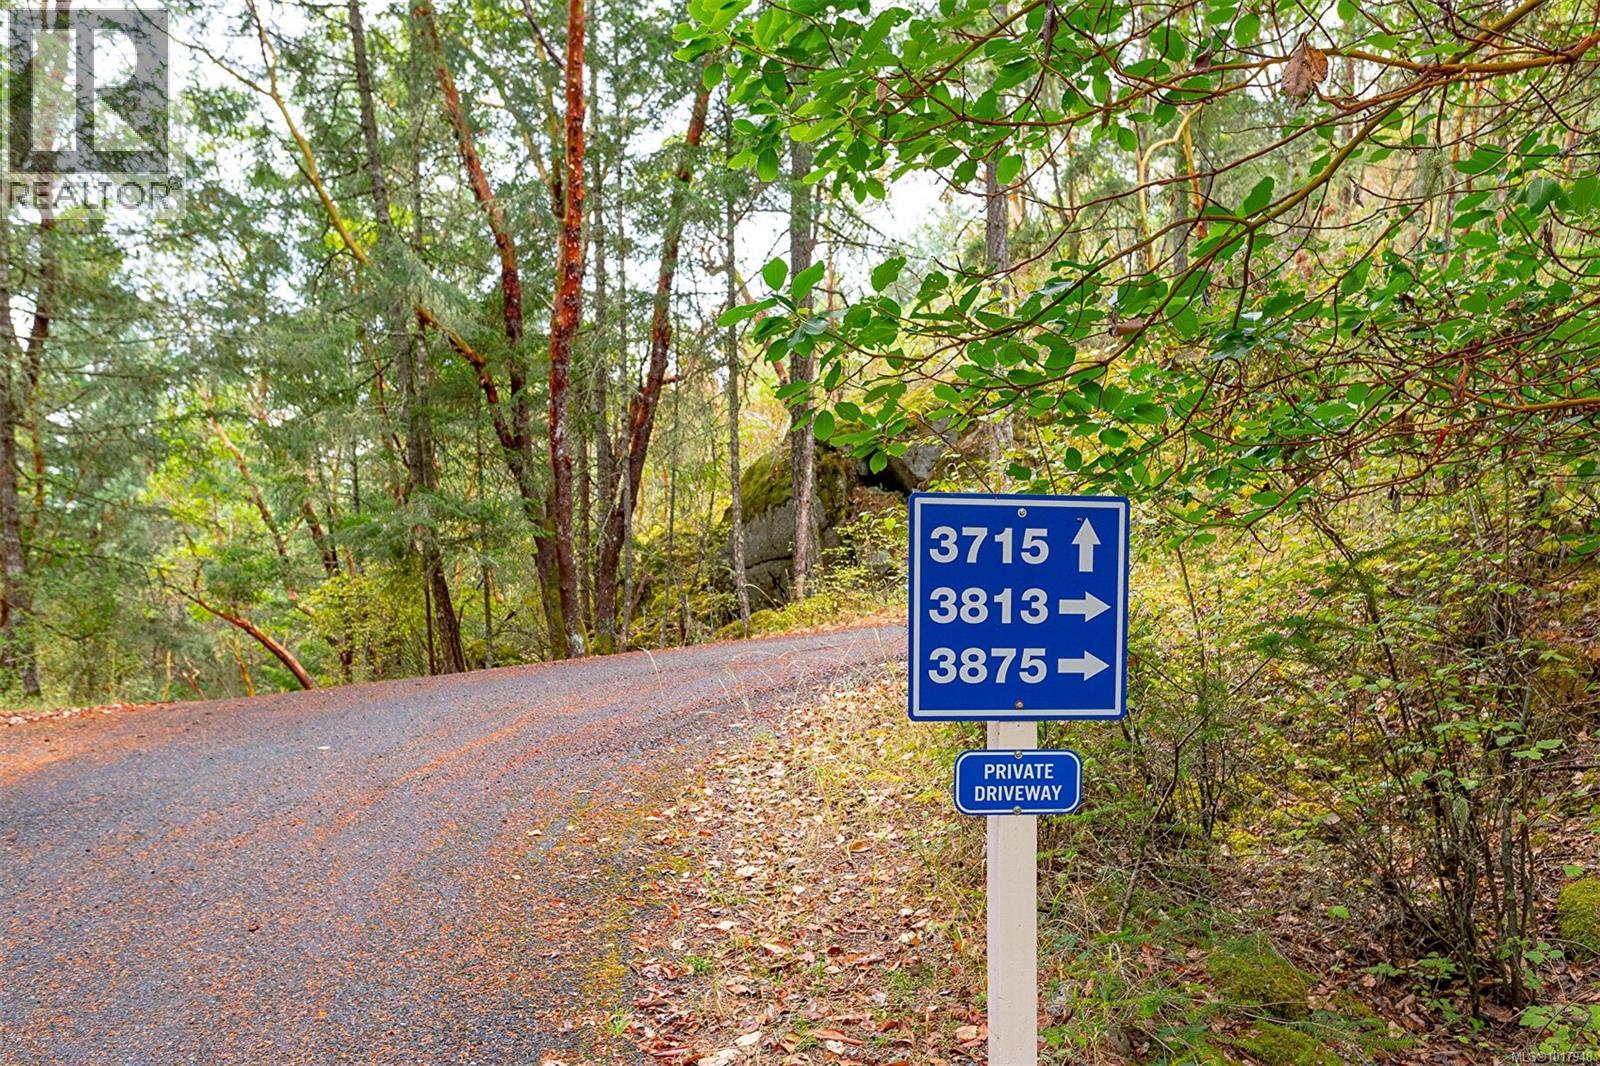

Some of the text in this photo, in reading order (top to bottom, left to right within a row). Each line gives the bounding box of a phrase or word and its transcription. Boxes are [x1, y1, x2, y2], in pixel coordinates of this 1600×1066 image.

[929, 526, 1050, 565] 3715
[928, 587, 1049, 624] 3813
[928, 647, 1048, 684] 3875
[984, 763, 1054, 780] PRIVATE
[974, 785, 1063, 802] DRIVEWAY
